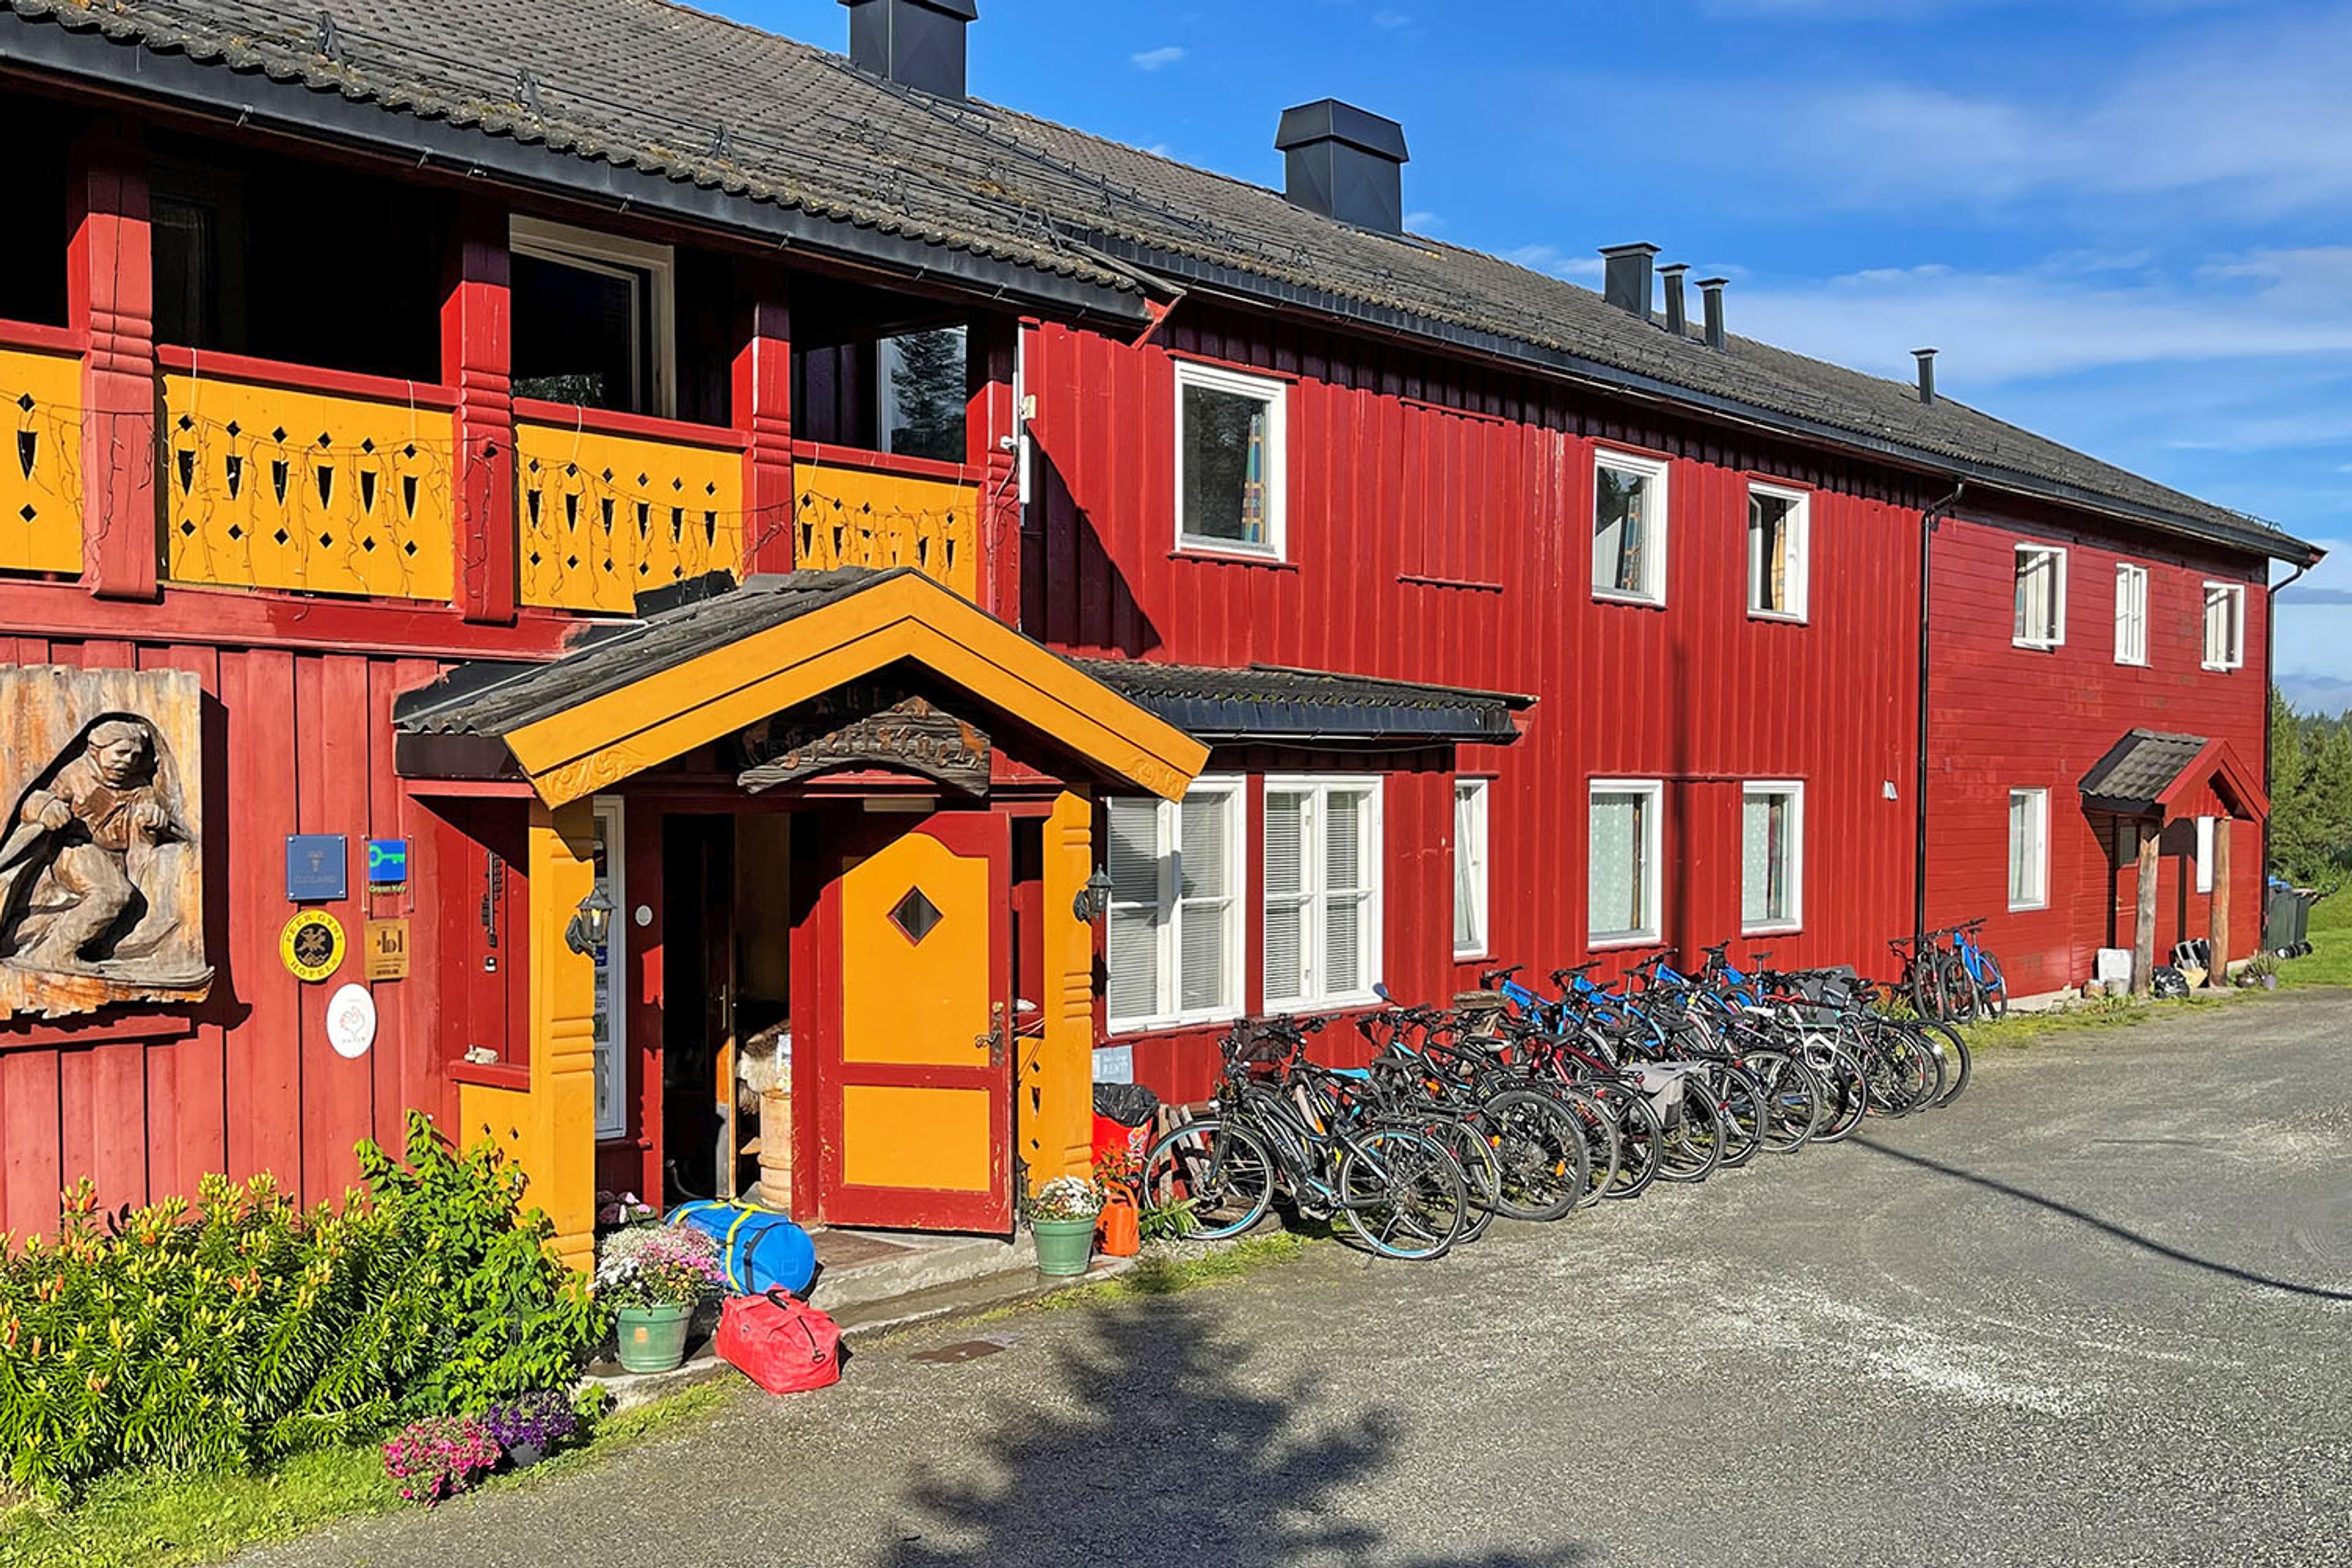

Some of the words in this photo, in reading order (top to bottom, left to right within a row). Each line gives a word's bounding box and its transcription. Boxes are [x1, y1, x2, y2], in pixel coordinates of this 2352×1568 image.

[285, 914, 312, 942] PEER
[317, 914, 342, 941] GYNT
[290, 959, 337, 978] HOTELS
